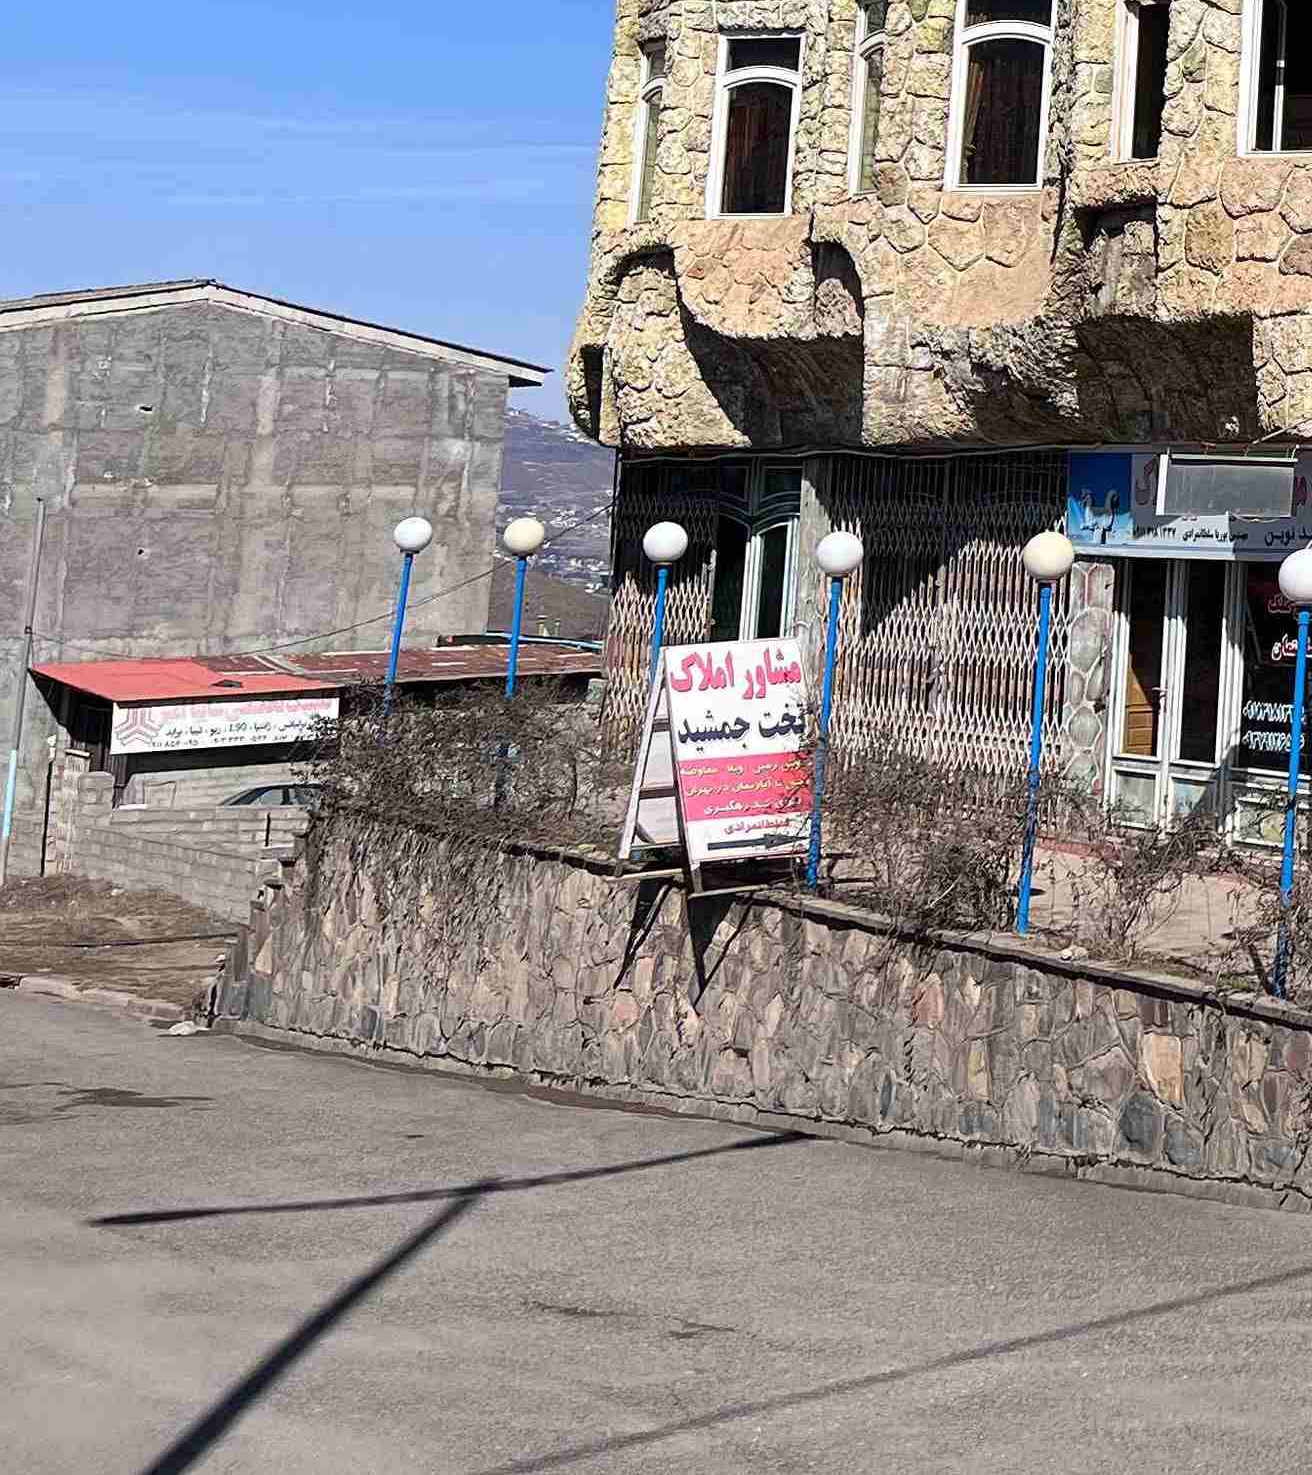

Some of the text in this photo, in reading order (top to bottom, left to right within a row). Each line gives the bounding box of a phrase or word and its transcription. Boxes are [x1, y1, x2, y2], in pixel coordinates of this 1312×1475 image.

[670, 646, 801, 700] مشاور املاک
[678, 701, 807, 753] تخت جمشید
